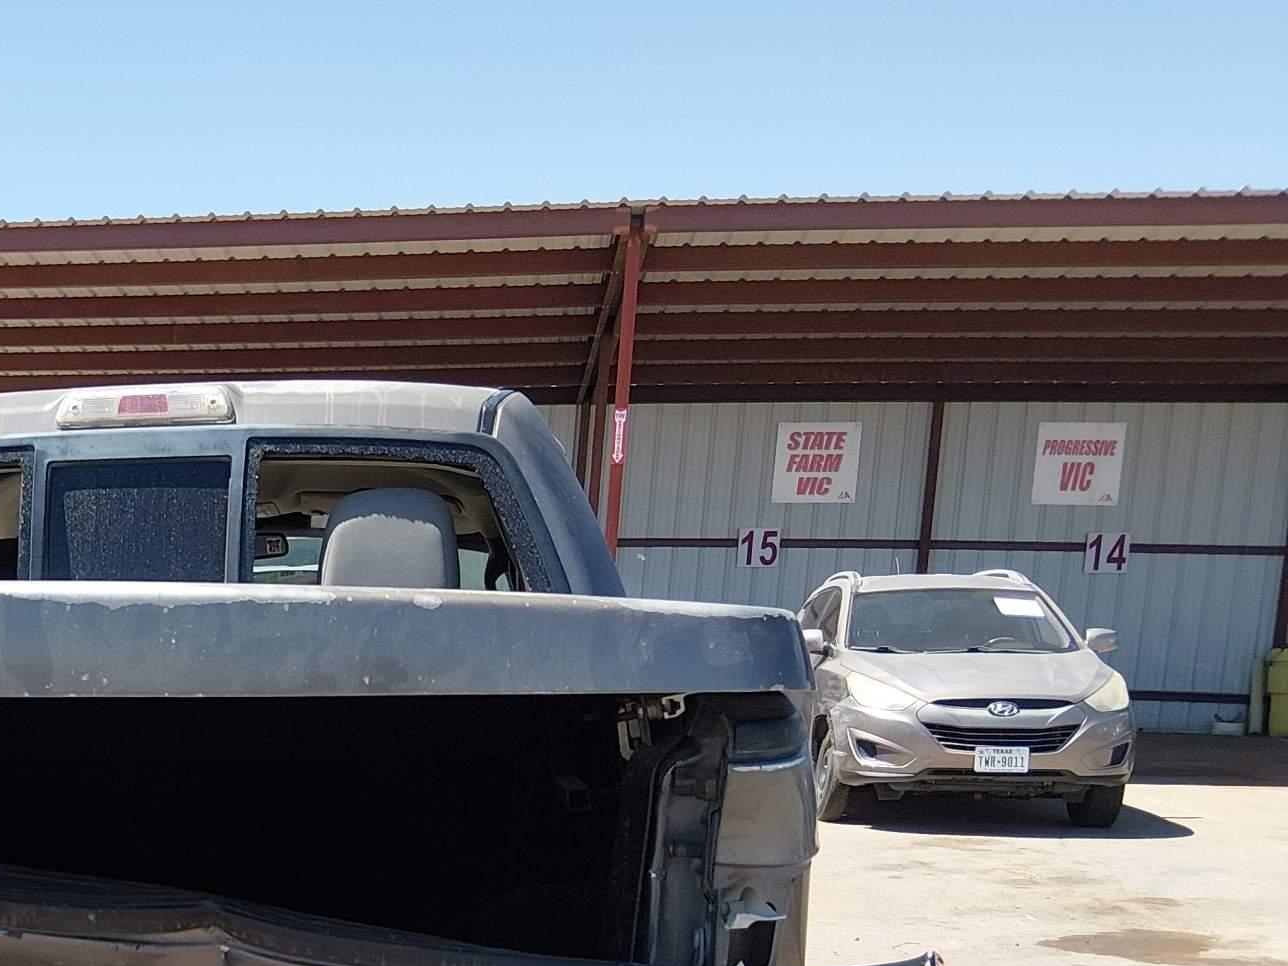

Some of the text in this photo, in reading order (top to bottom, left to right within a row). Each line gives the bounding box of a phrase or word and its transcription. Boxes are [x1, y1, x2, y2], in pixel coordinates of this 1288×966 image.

[787, 431, 848, 451] STATE
[1041, 439, 1118, 456] PROGRESSIVE
[785, 454, 844, 473] FARM
[796, 476, 833, 496] VIC
[1059, 461, 1095, 492] VIC
[741, 530, 778, 566] 15
[1088, 534, 1127, 571] 14
